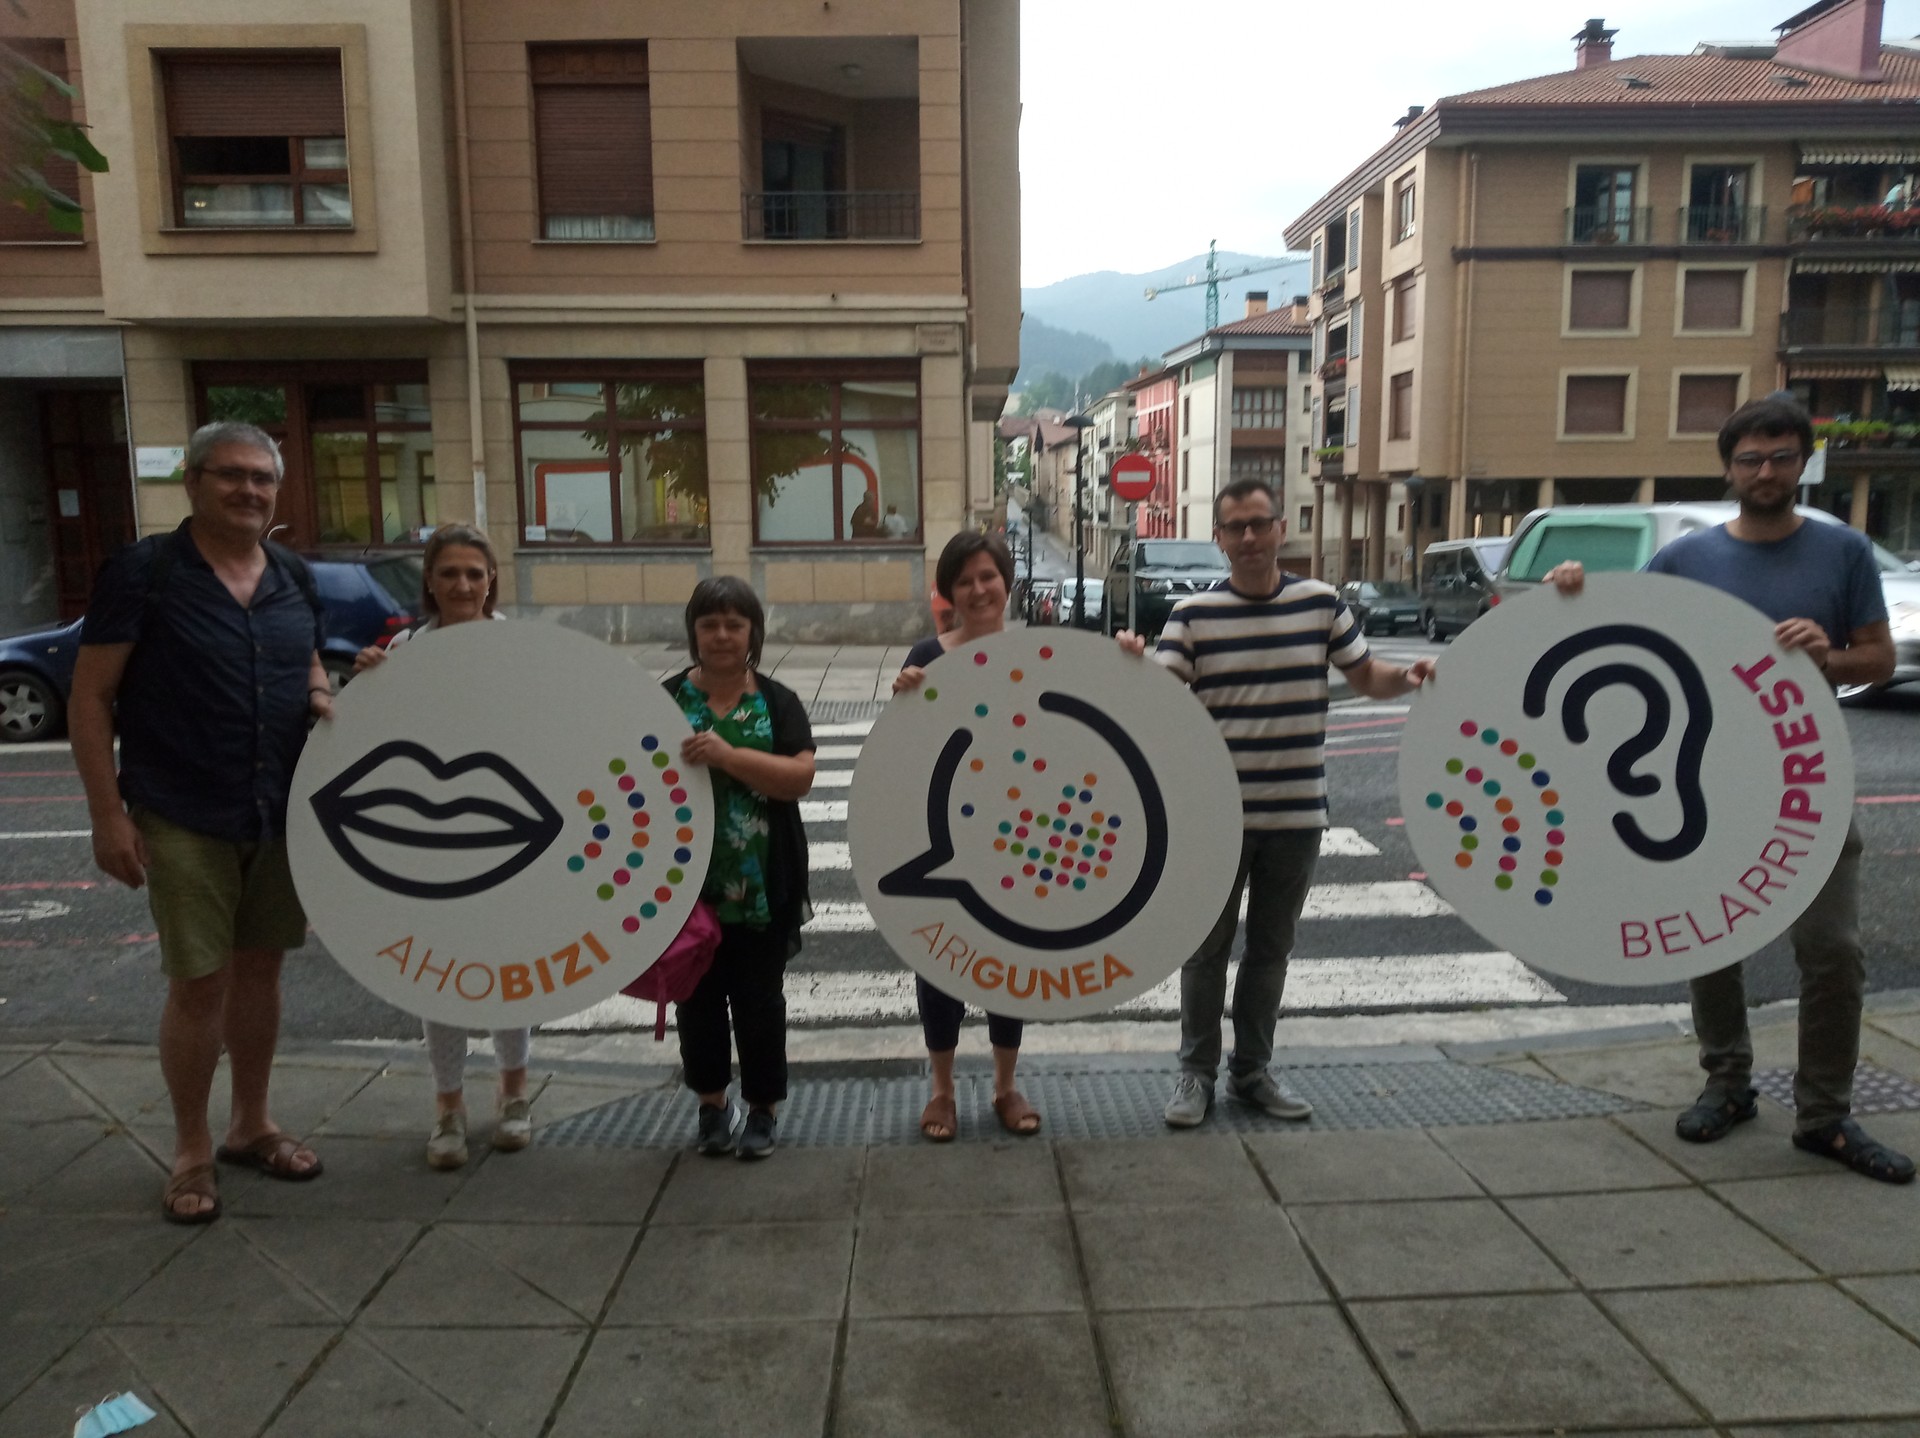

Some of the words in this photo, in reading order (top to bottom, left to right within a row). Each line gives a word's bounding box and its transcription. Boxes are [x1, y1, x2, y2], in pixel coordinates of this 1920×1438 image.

[1620, 654, 1827, 959] BELARRIPREST
[376, 931, 611, 1002] AHOBIZI
[911, 921, 1134, 1000] ARIGUNEA
